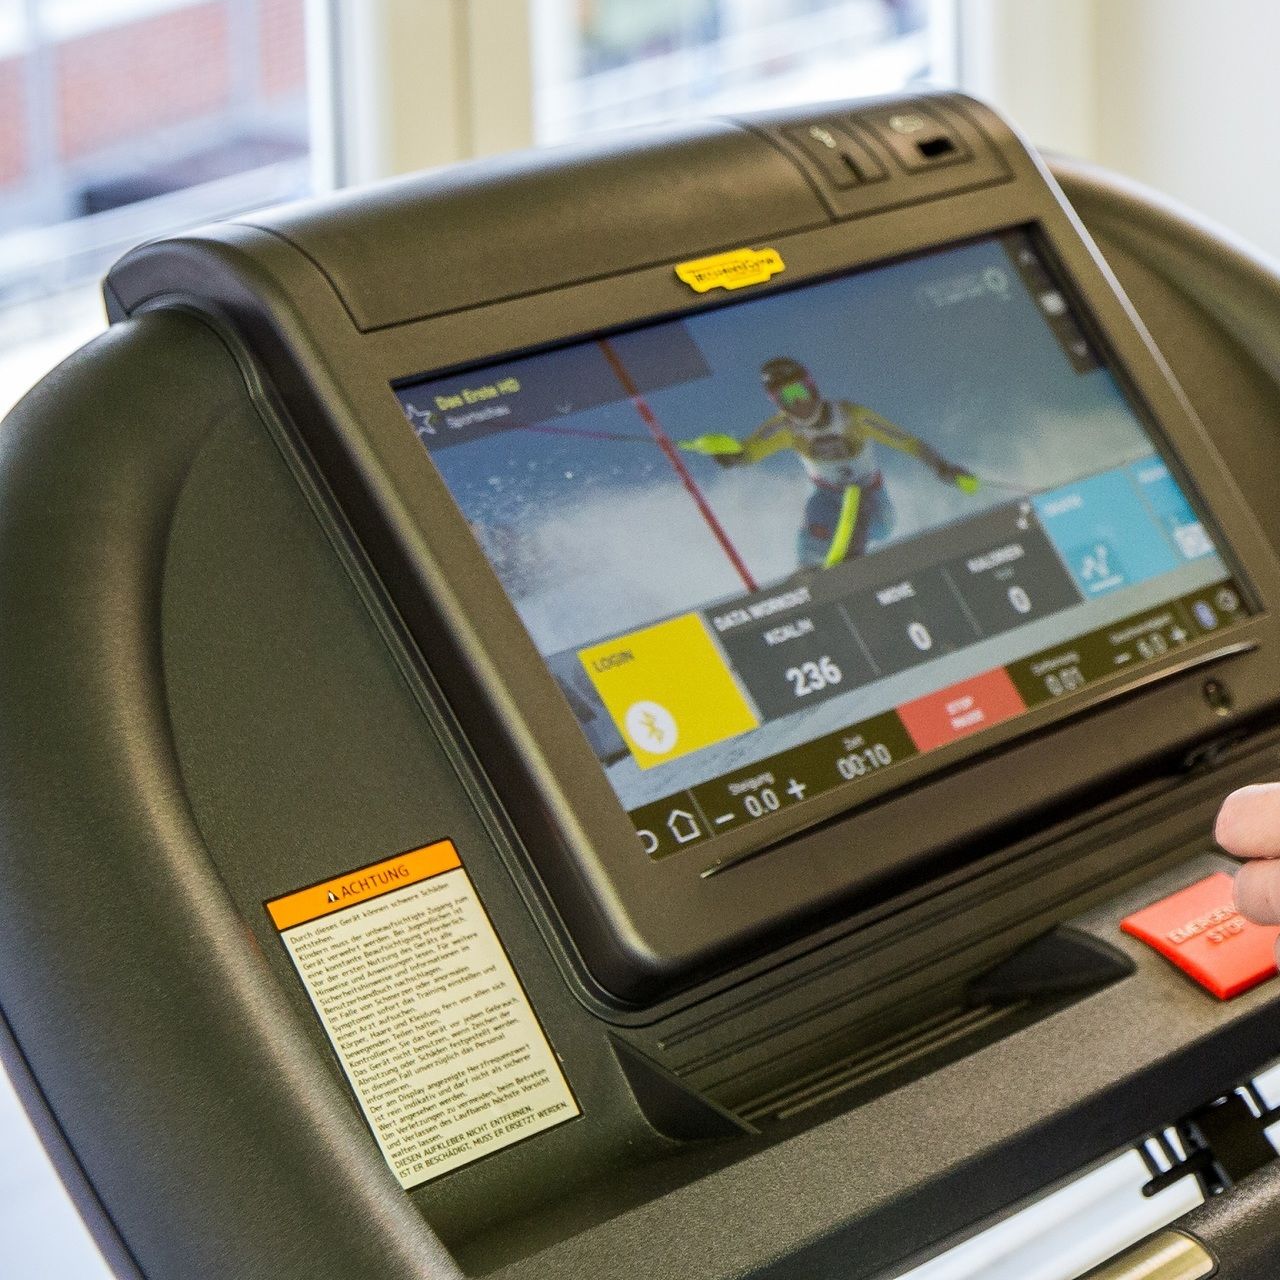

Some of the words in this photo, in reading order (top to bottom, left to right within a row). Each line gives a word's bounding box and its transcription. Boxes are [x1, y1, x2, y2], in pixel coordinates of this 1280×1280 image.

[1007, 586, 1031, 613] 0
[907, 622, 931, 650] 0
[591, 648, 635, 672] LOGIN
[785, 656, 841, 696] 236
[836, 743, 891, 779] 00:10
[744, 788, 779, 817] 0.0
[342, 864, 409, 898] ACHTUNG
[289, 931, 313, 944] Durch
[314, 923, 338, 935] dieses
[339, 914, 360, 926] Gerät
[298, 947, 328, 961] Kindern
[329, 939, 349, 950] muss
[350, 934, 362, 942] der
[302, 958, 325, 970] Gerät
[326, 944, 360, 961] verwehrt
[307, 969, 323, 979] eine
[324, 955, 361, 972] konstante
[362, 933, 422, 958] Beaufsichtigung
[310, 979, 323, 987] Vor
[326, 974, 338, 982] der
[341, 964, 366, 977] ersten
[366, 952, 399, 967] Nutzung
[399, 947, 413, 955] des
[314, 980, 348, 996] Hinweise
[350, 973, 365, 984] und
[366, 956, 413, 977] Anweisungen
[319, 974, 392, 1005] Sicherheitshinweise
[394, 966, 408, 977] und
[323, 984, 392, 1015] Benutzerhandbuch
[331, 1012, 375, 1033] Symptomen
[376, 1001, 400, 1015] sofort
[401, 997, 415, 1005] das
[415, 984, 447, 999] Training
[482, 964, 496, 974] und
[339, 1008, 357, 1018] Falle
[373, 987, 413, 1005] Schmerzen
[414, 980, 430, 990] oder
[336, 1029, 357, 1041] einen
[359, 1021, 376, 1032] Arzt
[369, 1026, 391, 1038] Haare
[393, 1019, 408, 1030] und
[408, 1007, 441, 1023] Kleidung
[441, 1001, 457, 1010] fern
[344, 1038, 390, 1059] bewegenden
[391, 1028, 414, 1040] Teilen
[348, 1045, 397, 1068] Kontrollieren
[398, 1040, 410, 1049] Sie
[411, 1035, 425, 1043] das
[425, 1024, 447, 1037] Gerät
[352, 1068, 367, 1078] Das
[368, 1058, 390, 1071] Gerät
[392, 1049, 412, 1061] nicht
[470, 1015, 498, 1030] Zeichen
[499, 1010, 510, 1018] der
[357, 1066, 399, 1086] Abnutzung
[399, 1058, 415, 1069] oder
[449, 1027, 490, 1048] festgestellt
[371, 1077, 397, 1091] diesem
[398, 1069, 412, 1080] Fall
[414, 1051, 459, 1074] unverzüglich
[460, 1046, 474, 1055] das
[474, 1032, 505, 1048] Personal
[369, 1104, 382, 1113] Der
[386, 1099, 397, 1107] am
[397, 1087, 425, 1102] Display
[427, 1070, 465, 1090] angezeigte
[381, 1131, 395, 1141] Um
[395, 1110, 445, 1134] Verletzungen
[446, 1106, 456, 1114] zu
[496, 1082, 514, 1092] beim
[514, 1068, 546, 1085] Betreten
[386, 1107, 402, 1117] rein
[403, 1093, 436, 1110] indikativ
[437, 1085, 452, 1096] und
[453, 1077, 468, 1090] darf
[470, 1070, 489, 1082] nicht
[491, 1066, 502, 1074] als
[502, 1054, 530, 1069] sicherer
[377, 1119, 397, 1131] Wert
[399, 1103, 437, 1123] angesehen
[386, 1138, 401, 1150] und
[401, 1124, 438, 1142] Verlassen
[439, 1118, 452, 1127] des
[453, 1102, 491, 1121] Laufbands
[520, 1076, 550, 1092] Vorsicht
[390, 1144, 417, 1158] walten
[394, 1151, 422, 1169] DIESEN
[423, 1133, 465, 1156] AUFKLEBER
[465, 1123, 487, 1137] NICHT
[398, 1167, 410, 1178] IST
[412, 1162, 423, 1172] ER
[472, 1133, 493, 1145] MUSS
[493, 1127, 504, 1137] ER
[504, 1113, 535, 1132] ERSETZT
